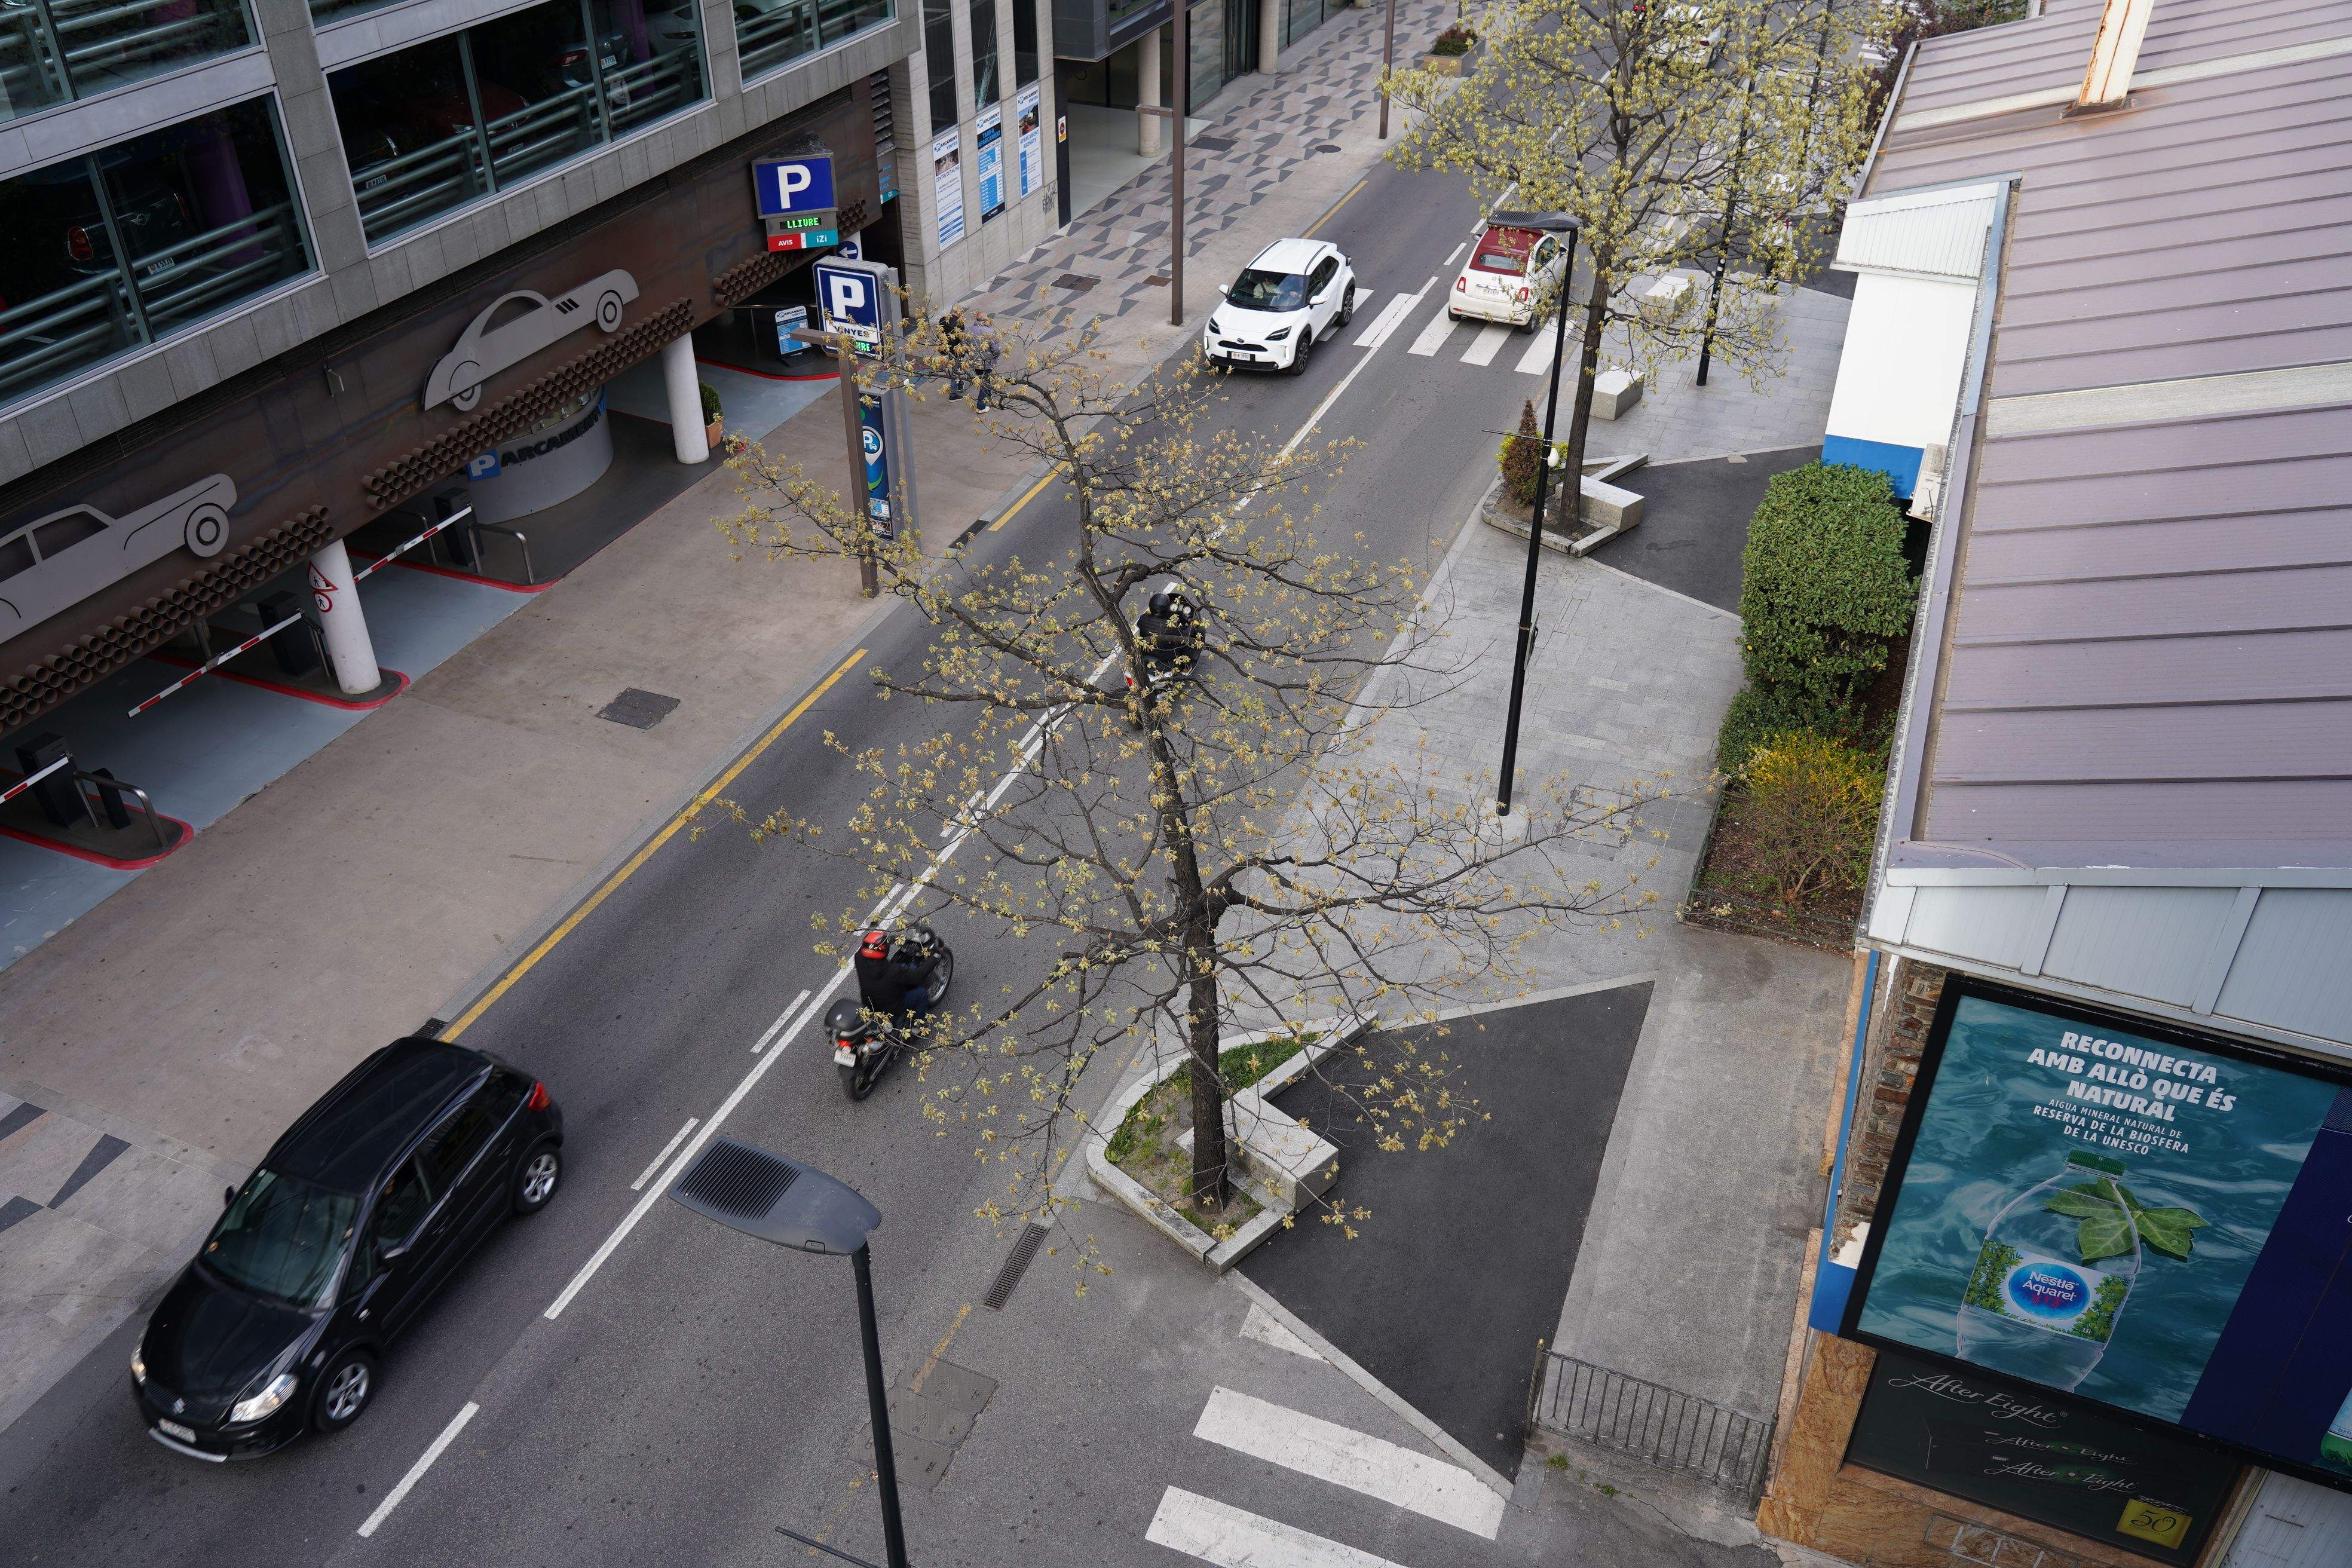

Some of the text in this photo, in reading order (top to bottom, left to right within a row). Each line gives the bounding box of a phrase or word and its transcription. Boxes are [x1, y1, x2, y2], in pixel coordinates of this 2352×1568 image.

[777, 164, 811, 210] P
[786, 217, 819, 229] LLIURE
[816, 234, 828, 243] iZi
[829, 274, 865, 321] P
[2060, 1031, 2218, 1085] RECONNECTA
[2026, 1048, 2237, 1113] AMB ALLÒ QUE ÉS
[2048, 1098, 2183, 1138] AIGUA MINERAL NATURAL DE
[2066, 1080, 2176, 1122] NATURAL
[2033, 1105, 2190, 1154] RESERVA DE LA BIOSFERA
[2063, 1125, 2150, 1156] DE LA UNESCO
[2022, 1279, 2075, 1301] Aquarel
[1888, 1372, 1984, 1404] After
[1983, 1436, 2140, 1465] After Eight
[1983, 1462, 2061, 1481] After
[2082, 1473, 2139, 1493] Eight
